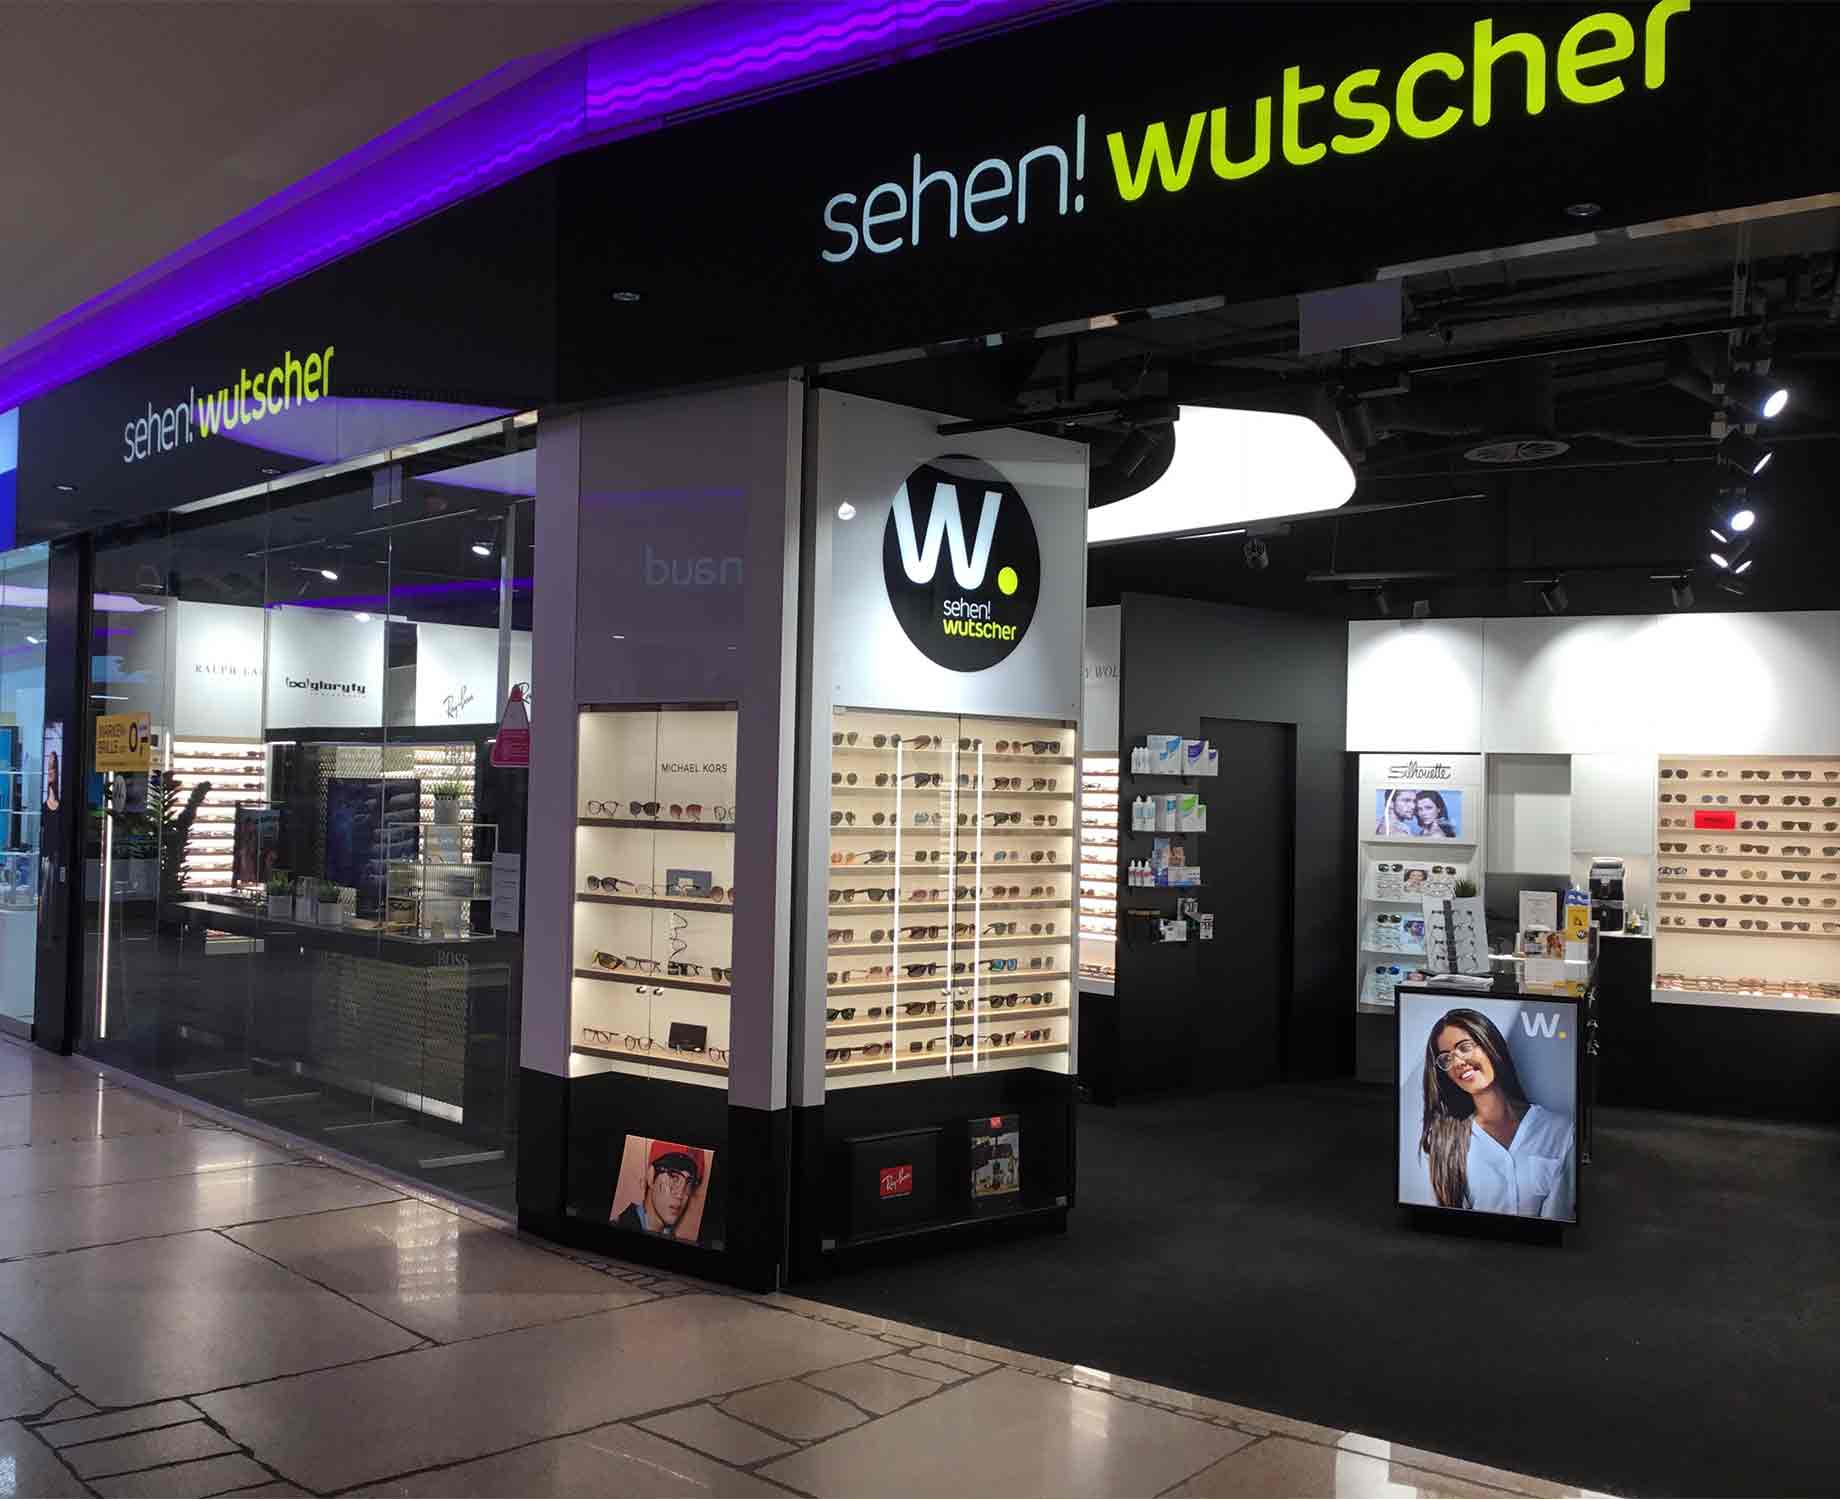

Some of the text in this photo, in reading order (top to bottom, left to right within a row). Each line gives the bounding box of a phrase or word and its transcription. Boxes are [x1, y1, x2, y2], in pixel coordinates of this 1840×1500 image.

[822, 0, 1691, 263] sehen! wutscher
[123, 346, 334, 463] sehen! wutscher
[943, 597, 1017, 640] sehen! wutscher
[662, 763, 727, 773] MICHAEL KORS
[1387, 760, 1451, 780] Silhouette
